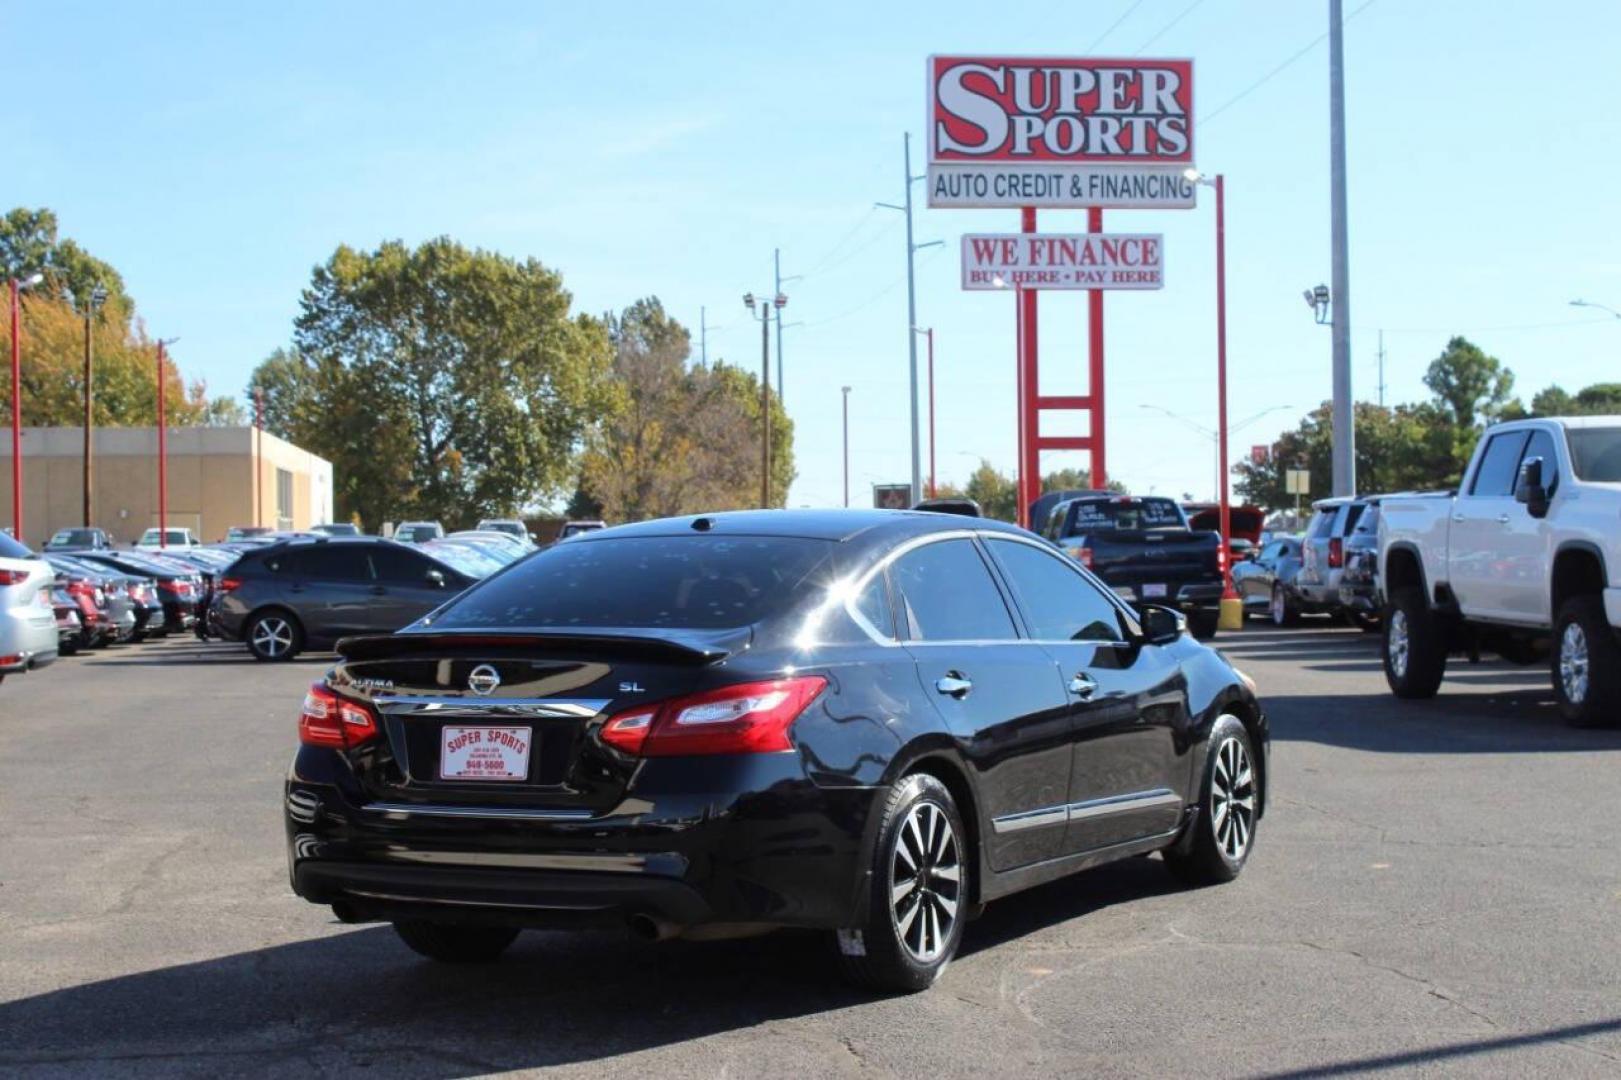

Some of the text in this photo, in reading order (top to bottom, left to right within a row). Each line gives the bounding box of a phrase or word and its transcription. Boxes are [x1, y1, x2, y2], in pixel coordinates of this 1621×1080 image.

[937, 63, 1185, 155] SUPER
[935, 174, 1193, 199] AUTO CREDIT & FINANCING
[970, 238, 1159, 267] WE FINANCE
[1012, 270, 1060, 283] HERE
[1075, 270, 1107, 283] PAY
[1112, 270, 1160, 283] HERE
[619, 681, 646, 692] SL
[447, 729, 526, 754] SUPER SPORTS
